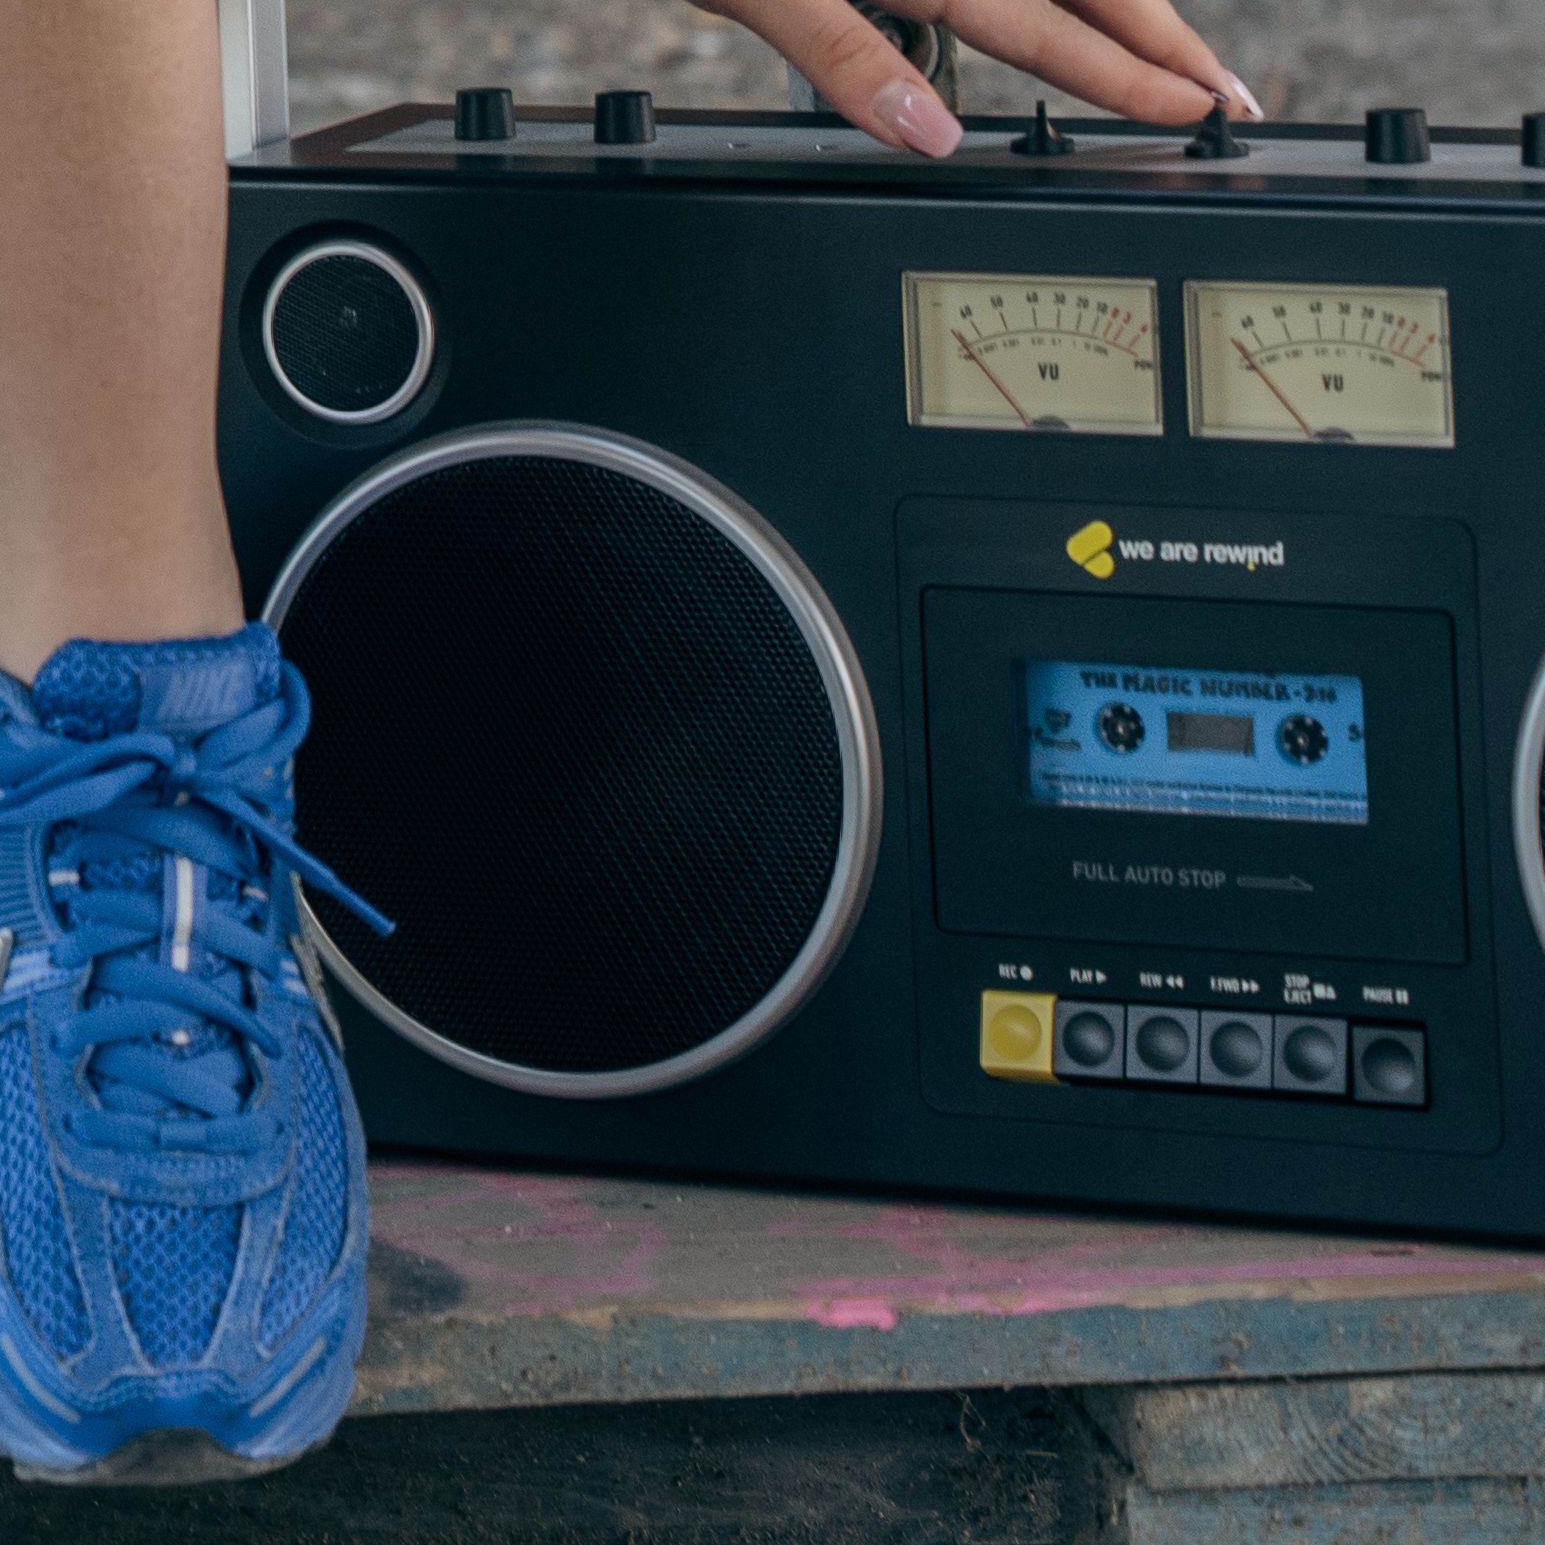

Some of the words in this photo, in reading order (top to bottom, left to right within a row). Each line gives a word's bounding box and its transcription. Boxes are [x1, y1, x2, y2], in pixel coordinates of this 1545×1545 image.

[1038, 362, 1059, 381] VU
[1322, 373, 1344, 392] VU
[1119, 539, 1154, 560] we
[1160, 541, 1198, 563] are
[1204, 541, 1284, 571] rewind
[1123, 673, 1193, 696] MAGIC
[1072, 860, 1120, 882] FULL
[1124, 865, 1174, 886] AUTO
[1178, 868, 1226, 888] STOP
[999, 963, 1017, 980] REC
[1070, 968, 1093, 984] PLAY
[1139, 972, 1163, 988] REW
[1284, 973, 1310, 988] STOP
[1362, 986, 1393, 1003] PAUSE
